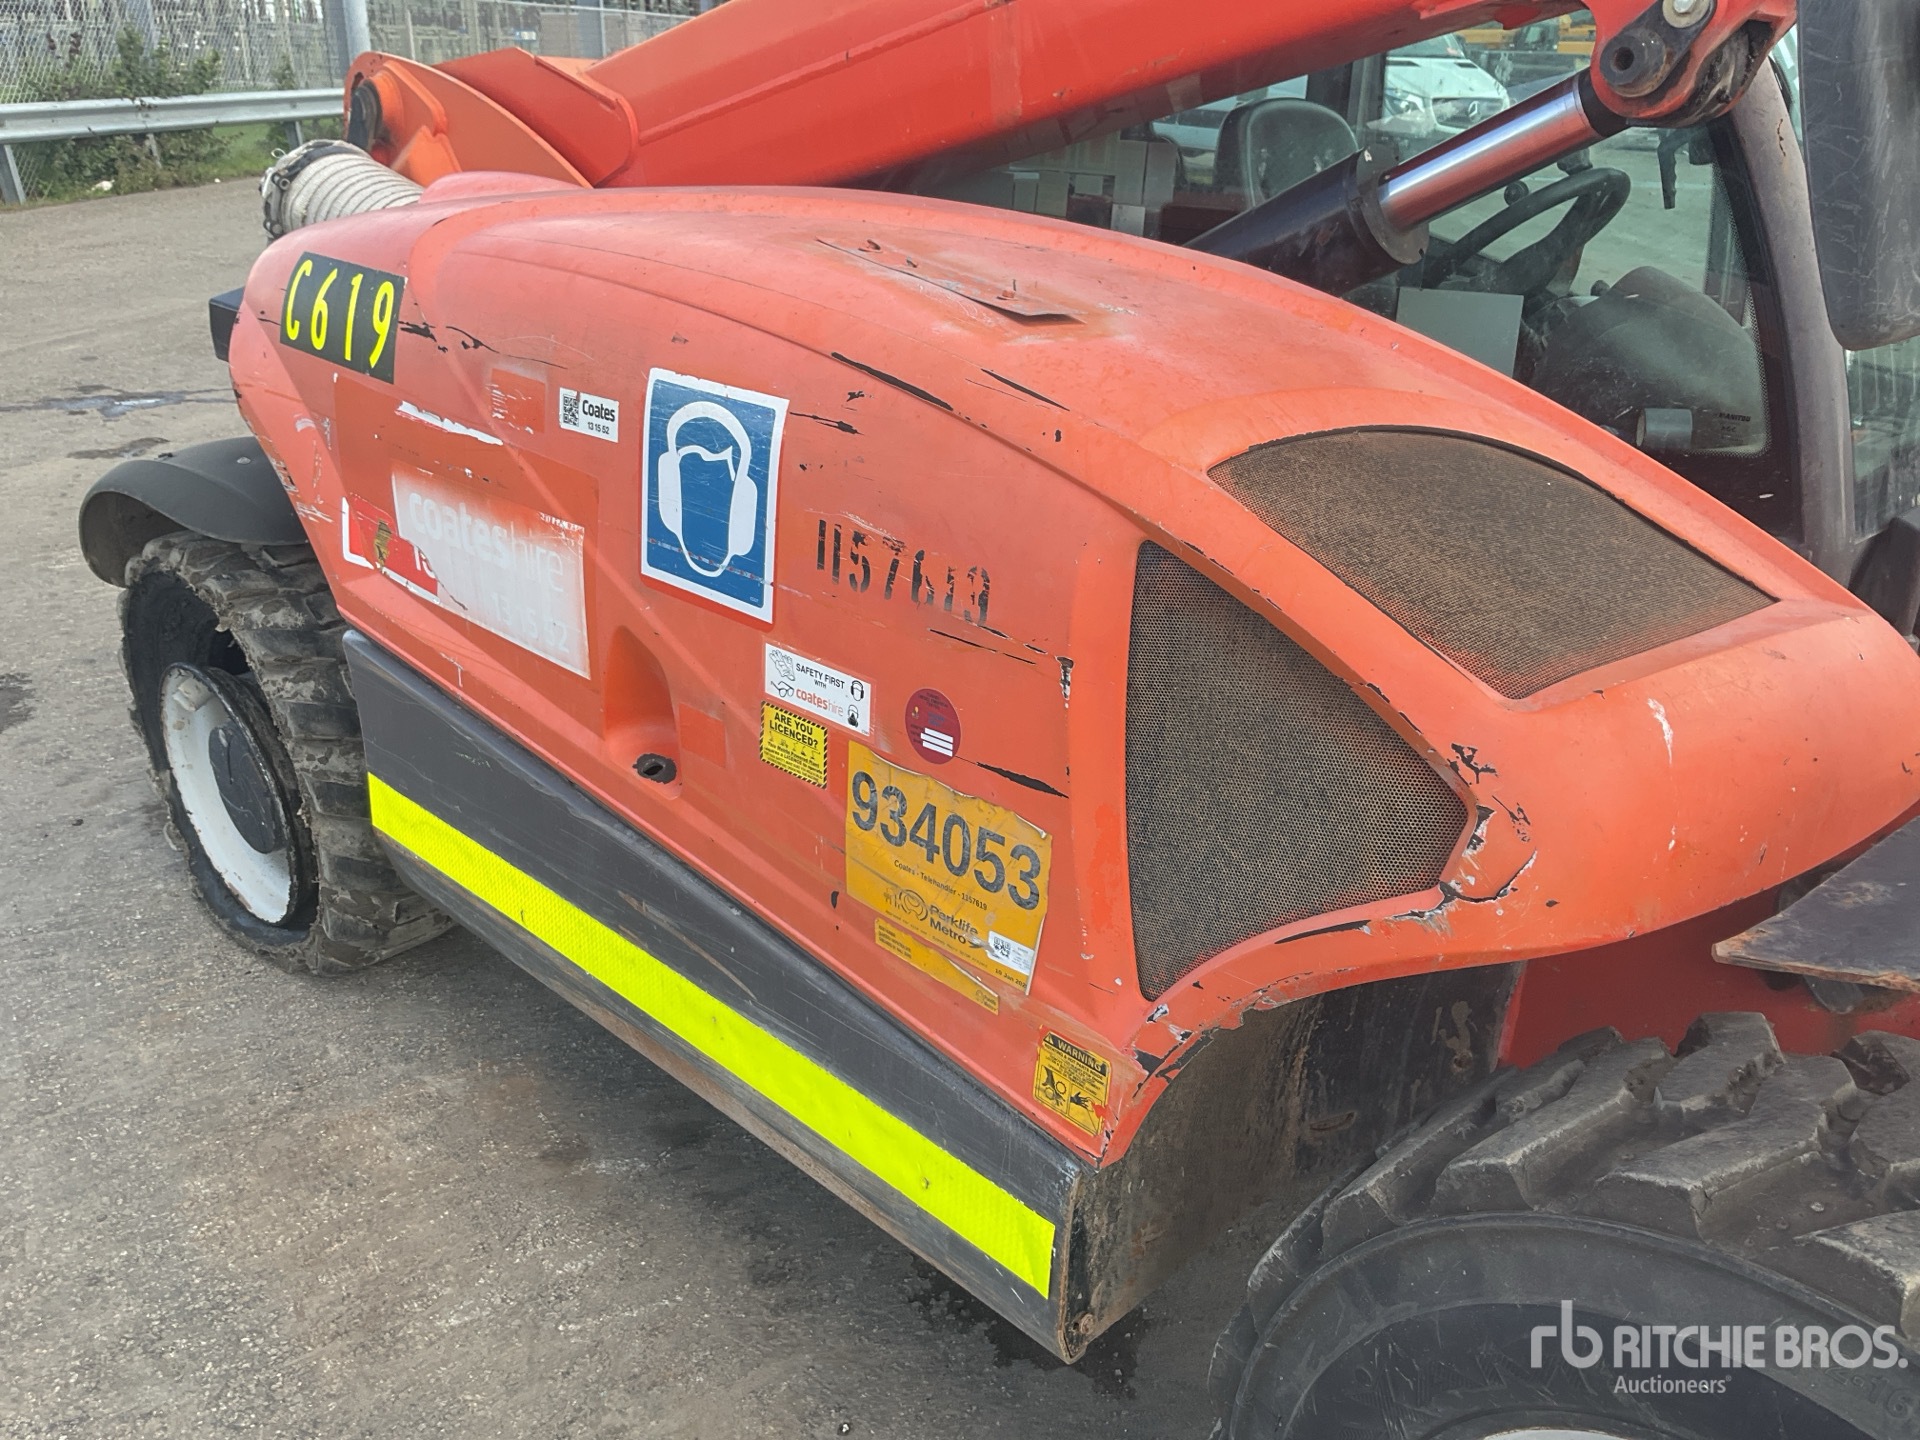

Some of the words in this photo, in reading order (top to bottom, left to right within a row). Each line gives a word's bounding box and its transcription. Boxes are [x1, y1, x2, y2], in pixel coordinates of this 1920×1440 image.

[285, 259, 395, 369] C619
[582, 399, 615, 422] Coates
[587, 421, 594, 431] 13
[595, 423, 602, 432] 15
[602, 425, 610, 435] 52
[796, 663, 823, 680] SAFETY
[824, 674, 845, 689] FIRST
[814, 679, 826, 689] WITH
[769, 720, 818, 748] LICENCED?
[774, 712, 792, 726] ARE
[794, 720, 813, 735] YOU
[851, 771, 1041, 910] 934053
[894, 860, 915, 875] Coates
[920, 872, 956, 895] Telehandler
[929, 904, 978, 934] Parklife
[929, 917, 966, 944] Metro
[1057, 1039, 1101, 1071] WARNING
